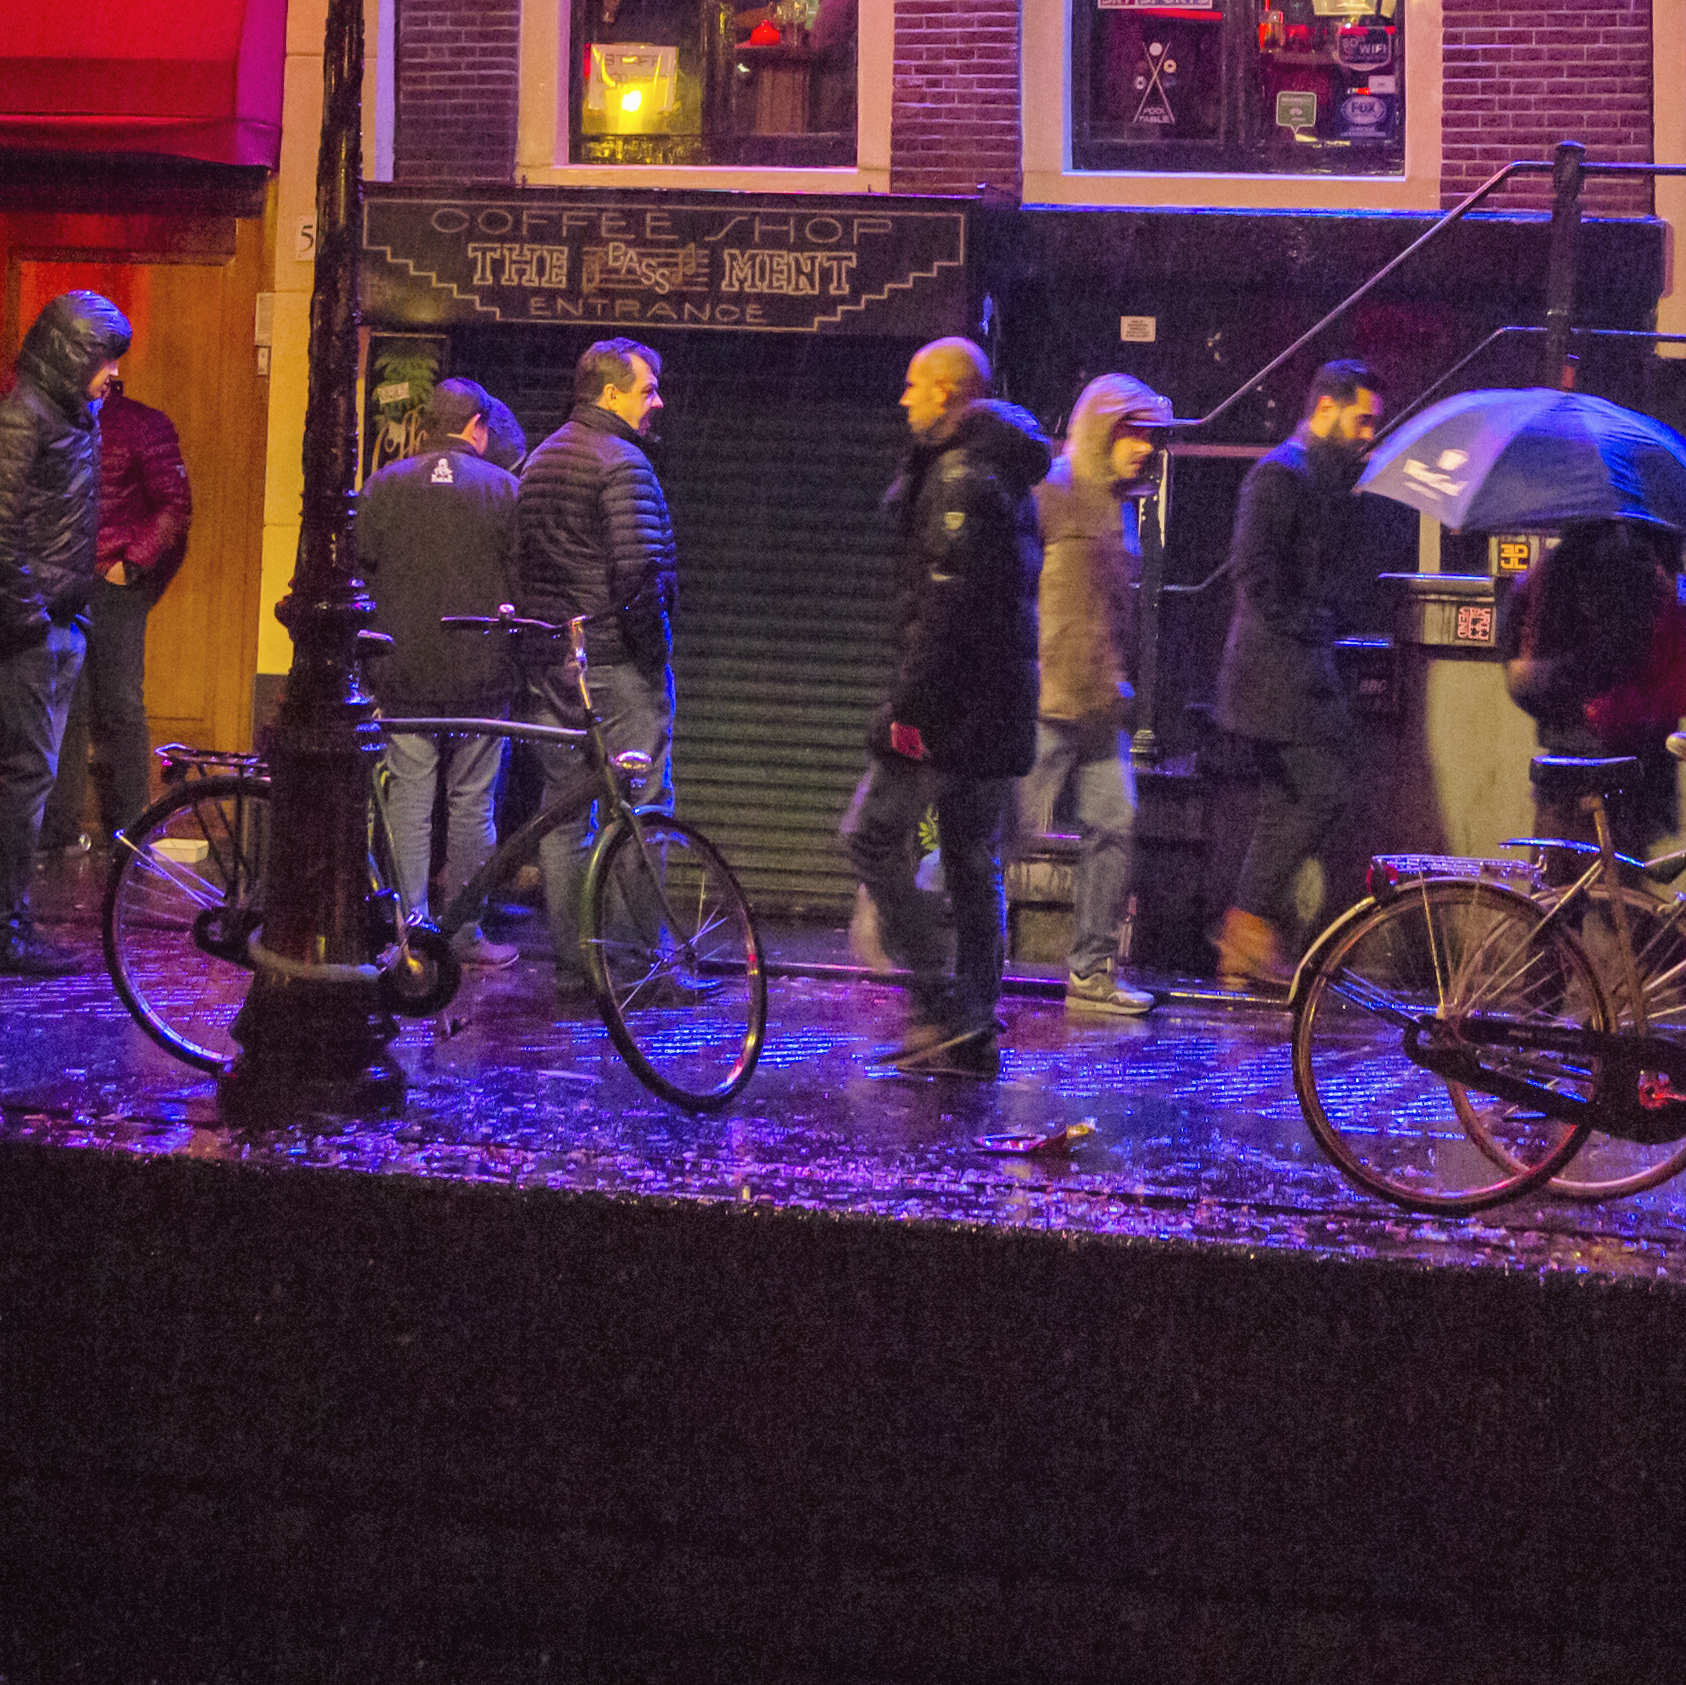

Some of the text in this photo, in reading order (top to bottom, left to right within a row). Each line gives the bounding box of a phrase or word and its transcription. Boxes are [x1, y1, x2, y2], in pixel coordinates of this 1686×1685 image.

[1358, 43, 1388, 55] WIFI
[431, 206, 893, 245] COFFEE SHOP
[468, 241, 858, 296] THE BASS MENT
[528, 297, 768, 324] ENTRANCE
